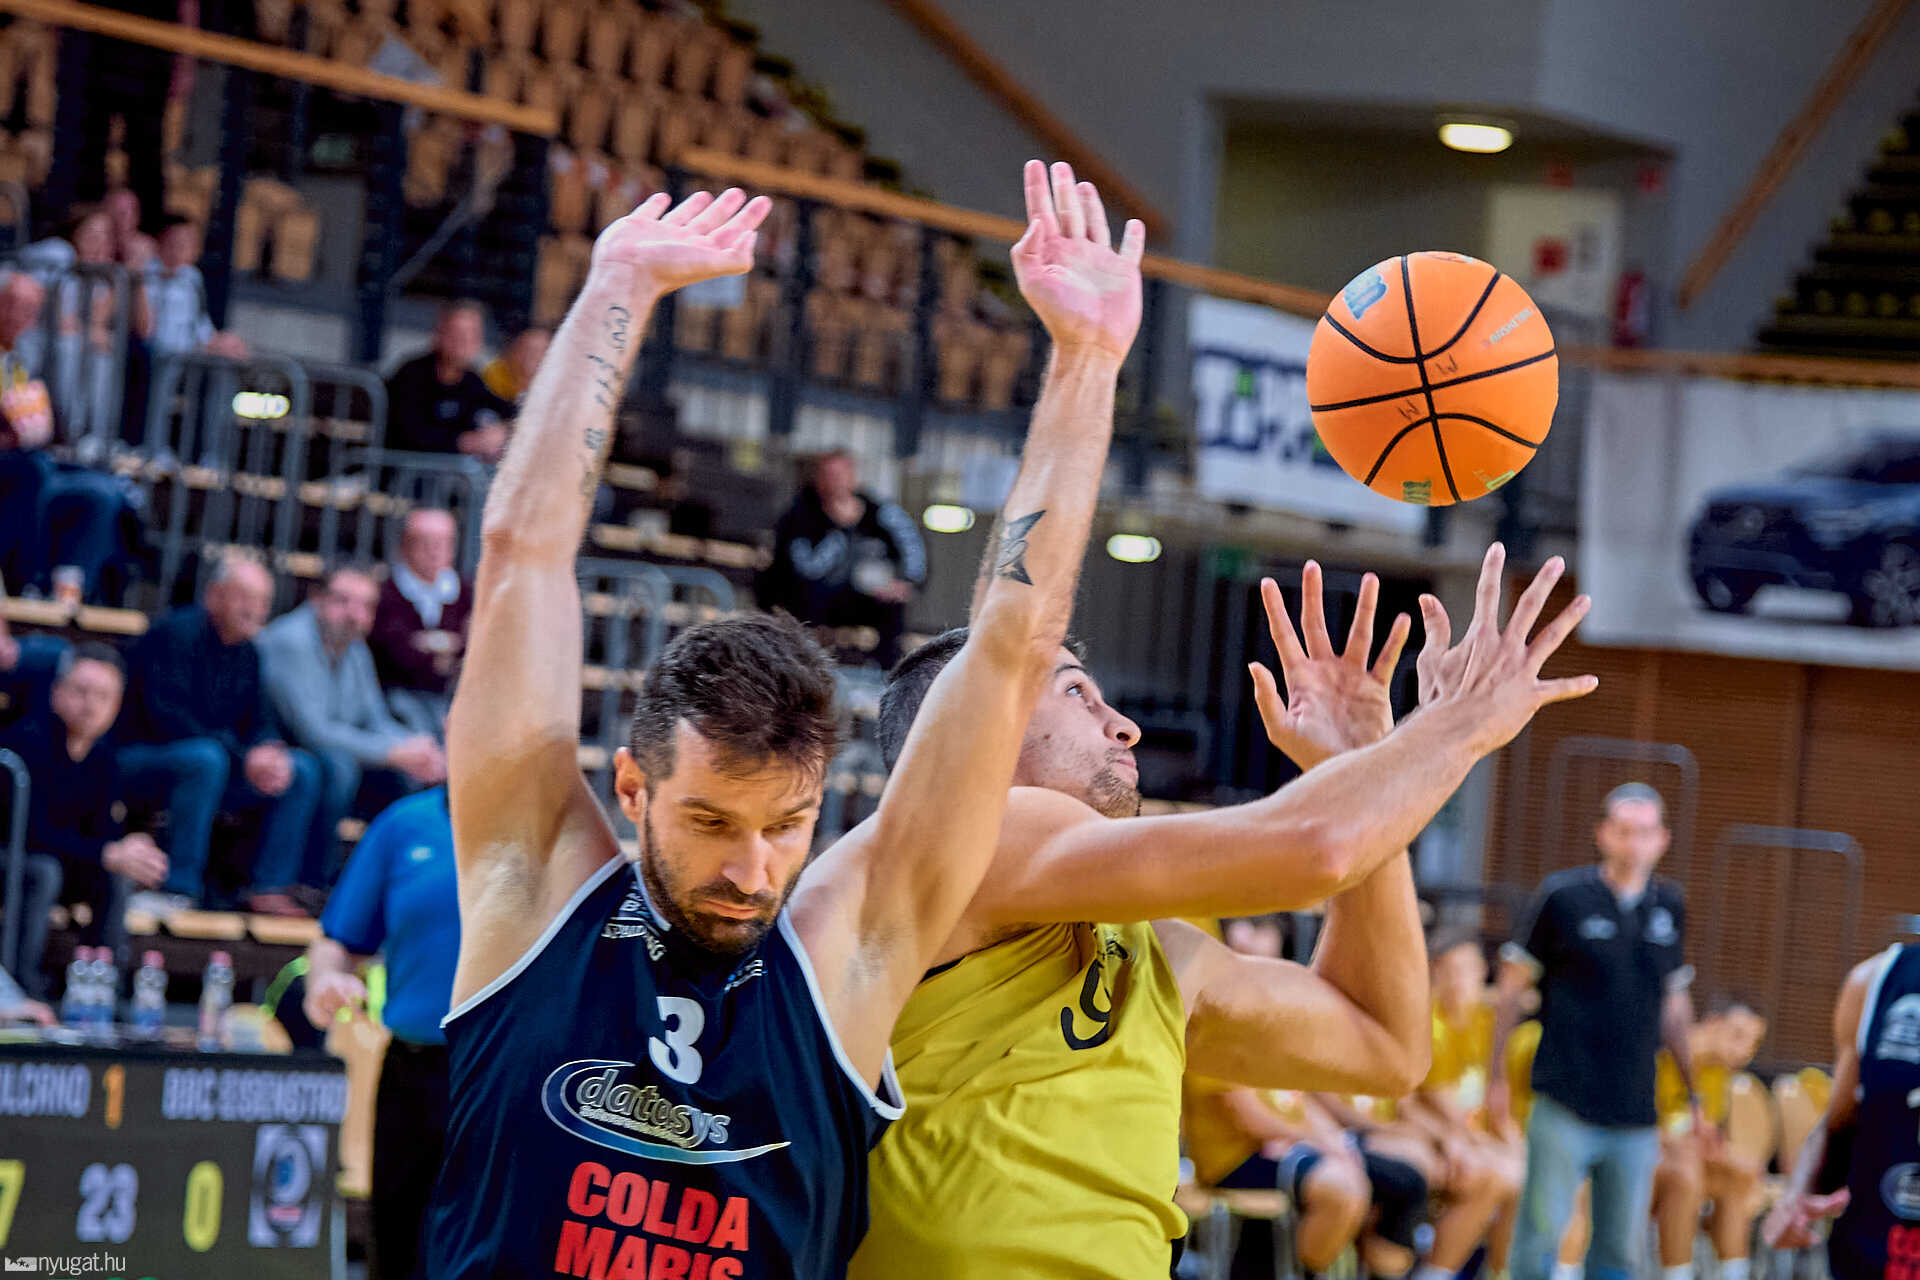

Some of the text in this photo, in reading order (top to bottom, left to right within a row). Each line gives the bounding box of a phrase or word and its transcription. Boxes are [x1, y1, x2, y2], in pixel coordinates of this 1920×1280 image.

[648, 996, 705, 1084] 3
[103, 1064, 126, 1129] 1
[0, 1159, 26, 1249] 7
[76, 1162, 139, 1244] 23
[182, 1161, 224, 1252] 0
[567, 1161, 750, 1252] COLDA
